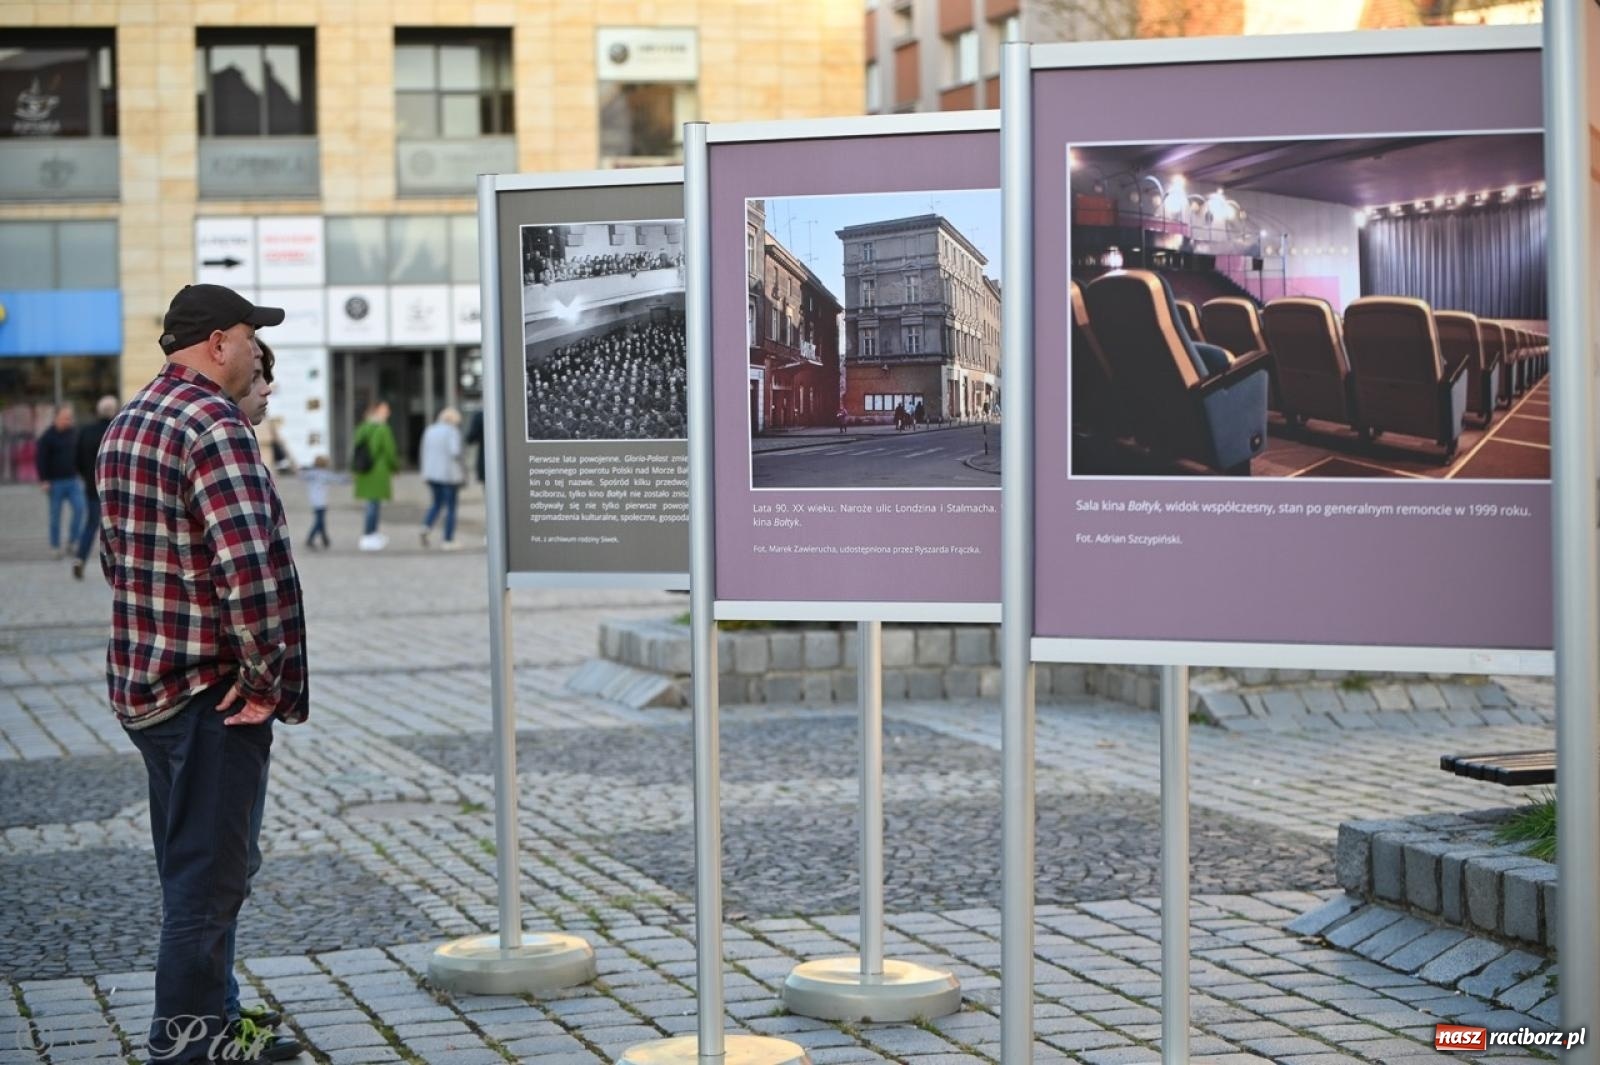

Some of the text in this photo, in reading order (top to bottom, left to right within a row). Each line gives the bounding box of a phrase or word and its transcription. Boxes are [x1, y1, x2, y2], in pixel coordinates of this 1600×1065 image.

[529, 455, 560, 463] Pierwsze
[563, 455, 576, 463] lata
[580, 456, 621, 465] powojenne.
[530, 467, 577, 476] powojennego
[612, 466, 633, 475] Polski
[635, 467, 649, 475] nad
[652, 467, 674, 475] Morze
[555, 479, 564, 488] tej
[634, 478, 651, 486] kilku
[569, 490, 587, 500] tylko
[589, 490, 604, 498] kino
[585, 502, 597, 510] nie
[602, 502, 620, 512] tylko
[625, 502, 657, 511] pierwsze
[753, 504, 772, 513] Lata
[775, 504, 789, 513] 90.
[792, 504, 804, 513] XX
[807, 504, 836, 513] wieku.
[840, 503, 872, 513] Naroże
[875, 503, 892, 513] ulic
[895, 503, 936, 513] Londzina
[947, 503, 997, 513] Stalmacha.
[1075, 500, 1099, 511] Sala
[1102, 500, 1125, 511] kina
[1165, 501, 1199, 512] widok
[1202, 501, 1276, 516] współczesny,
[1279, 503, 1303, 514] stan
[1306, 504, 1322, 516] po
[1323, 503, 1393, 517] generalnym
[1396, 504, 1452, 515] remoncie
[1455, 506, 1465, 515] w
[1469, 504, 1498, 516] 1999
[1500, 504, 1532, 517] roku.
[753, 517, 772, 527] kina
[1075, 533, 1183, 546] Fot. Adrian Szczypiński.
[769, 545, 792, 553] Marek
[840, 545, 891, 555] udostępniona
[893, 547, 914, 555] przez
[915, 545, 949, 555] Ryszarda
